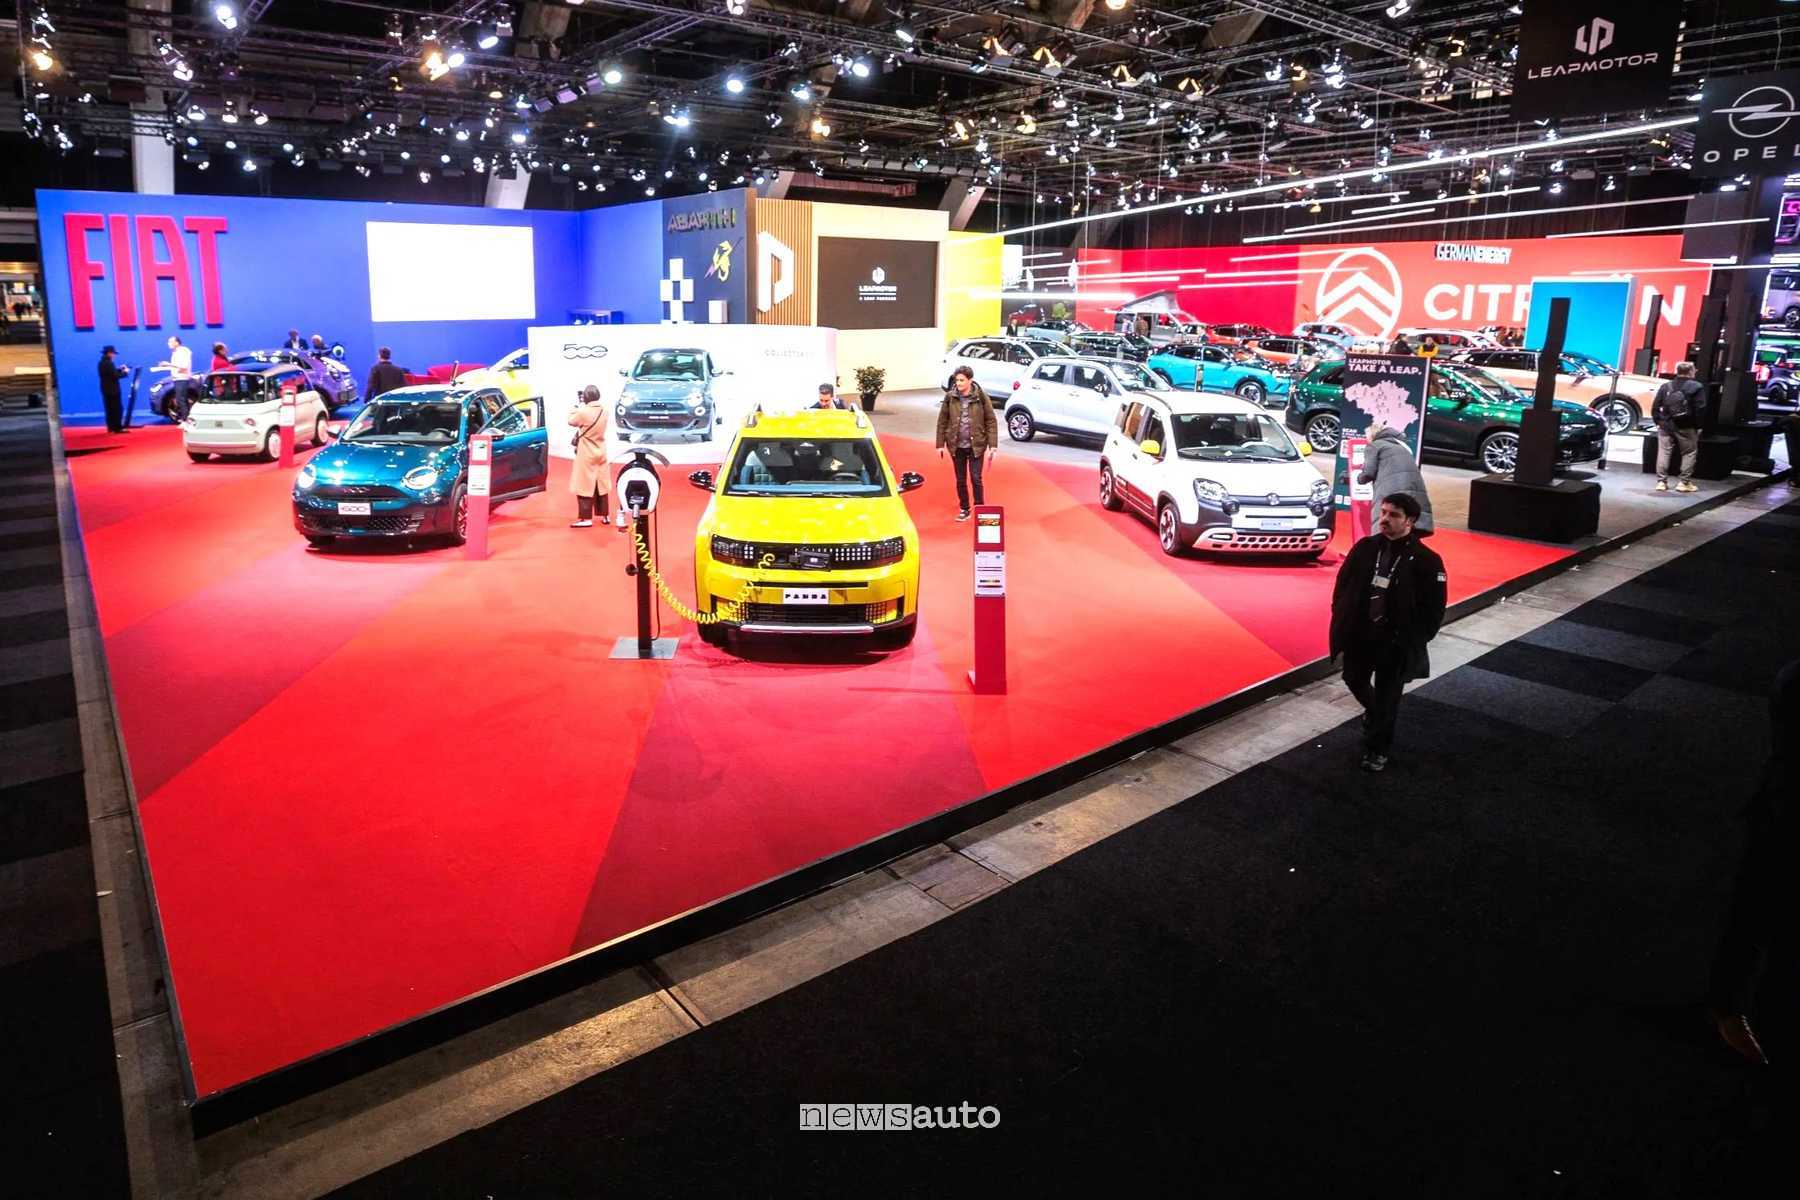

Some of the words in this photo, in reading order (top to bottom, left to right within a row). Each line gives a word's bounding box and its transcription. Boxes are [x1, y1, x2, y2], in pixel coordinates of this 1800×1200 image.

[1528, 52, 1659, 79] LEAPMOTOR
[64, 213, 228, 330] FIAT
[1423, 283, 1687, 327] CITRN
[1348, 363, 1377, 373] TAKE
[1378, 365, 1388, 374] A
[1389, 365, 1422, 375] LEAP.
[784, 592, 828, 600] PANDA
